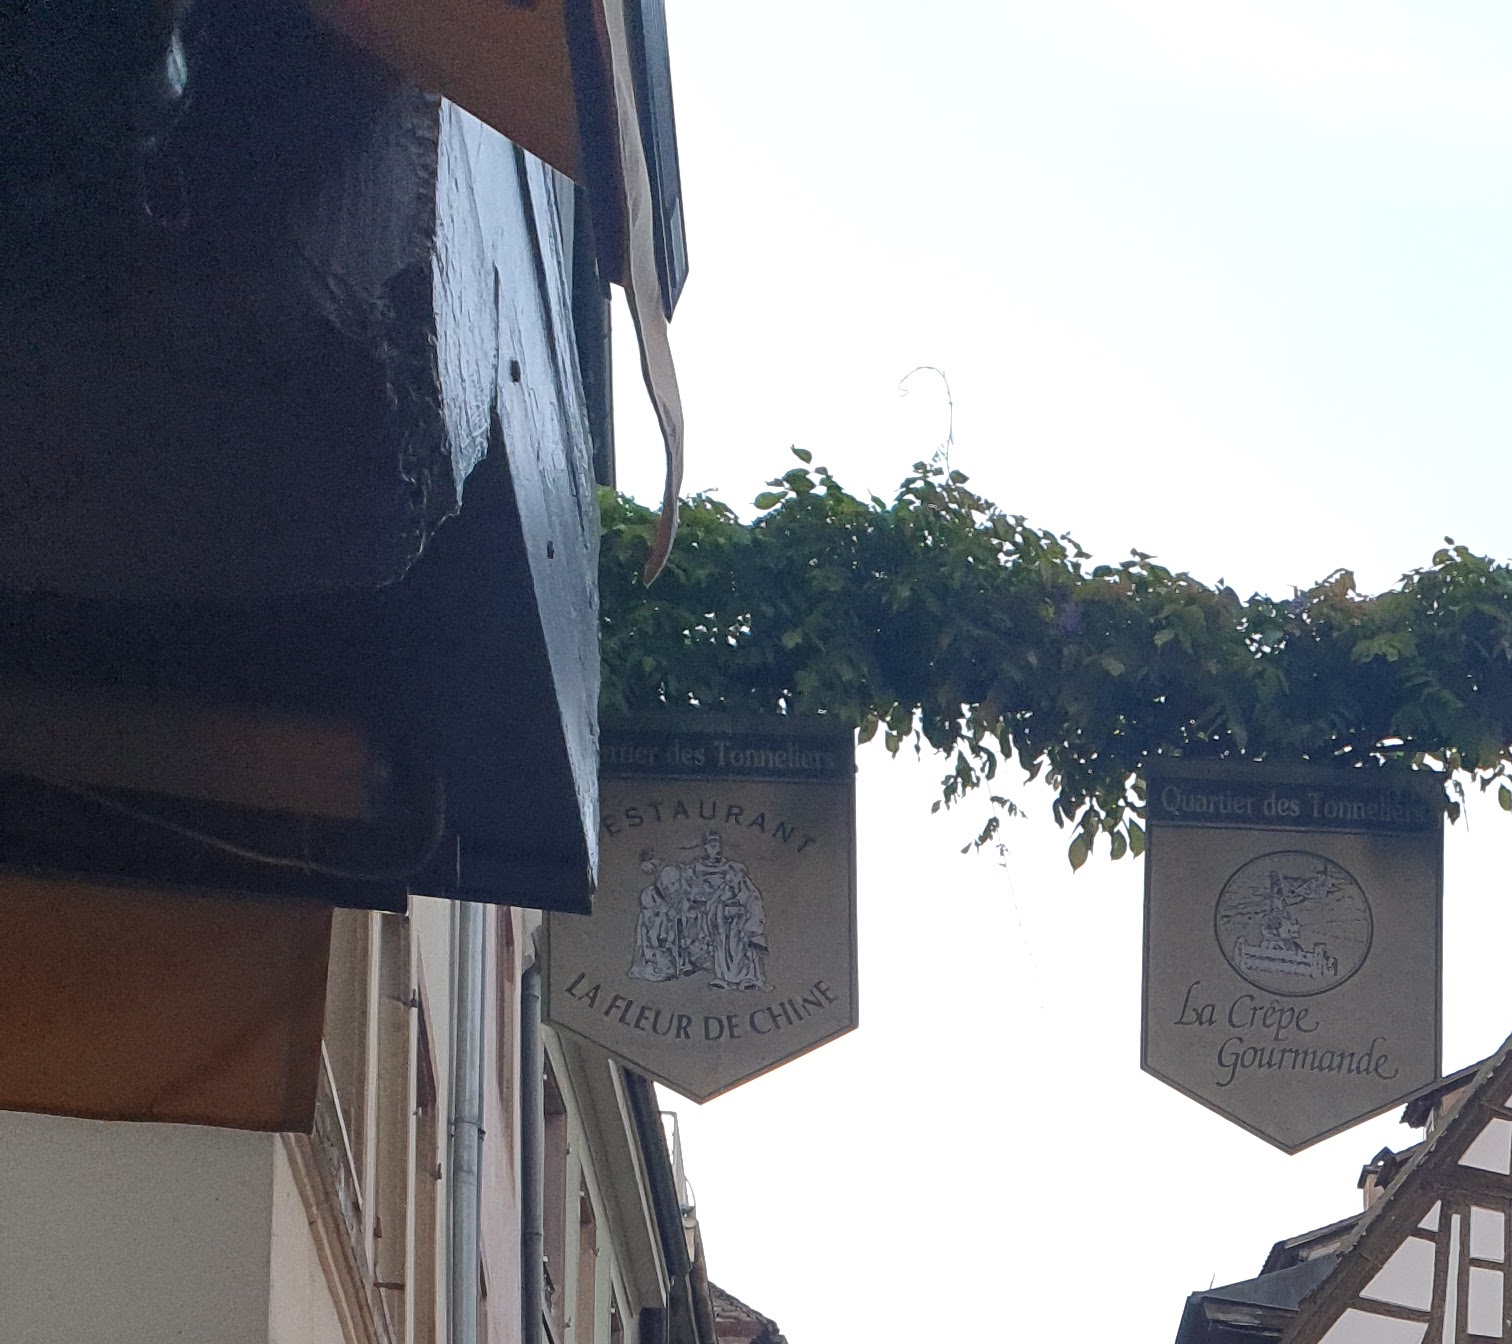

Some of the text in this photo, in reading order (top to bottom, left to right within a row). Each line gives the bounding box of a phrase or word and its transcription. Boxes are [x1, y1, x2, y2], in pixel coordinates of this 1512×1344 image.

[669, 739, 705, 766] des
[603, 799, 818, 854] ESTAURANT
[1160, 786, 1427, 823] Quartier des Tonneliers
[564, 972, 839, 1041] LA FLEUR DE CHINE
[1173, 981, 1320, 1042] La Crêpe
[1216, 1036, 1400, 1088] Gourmande
